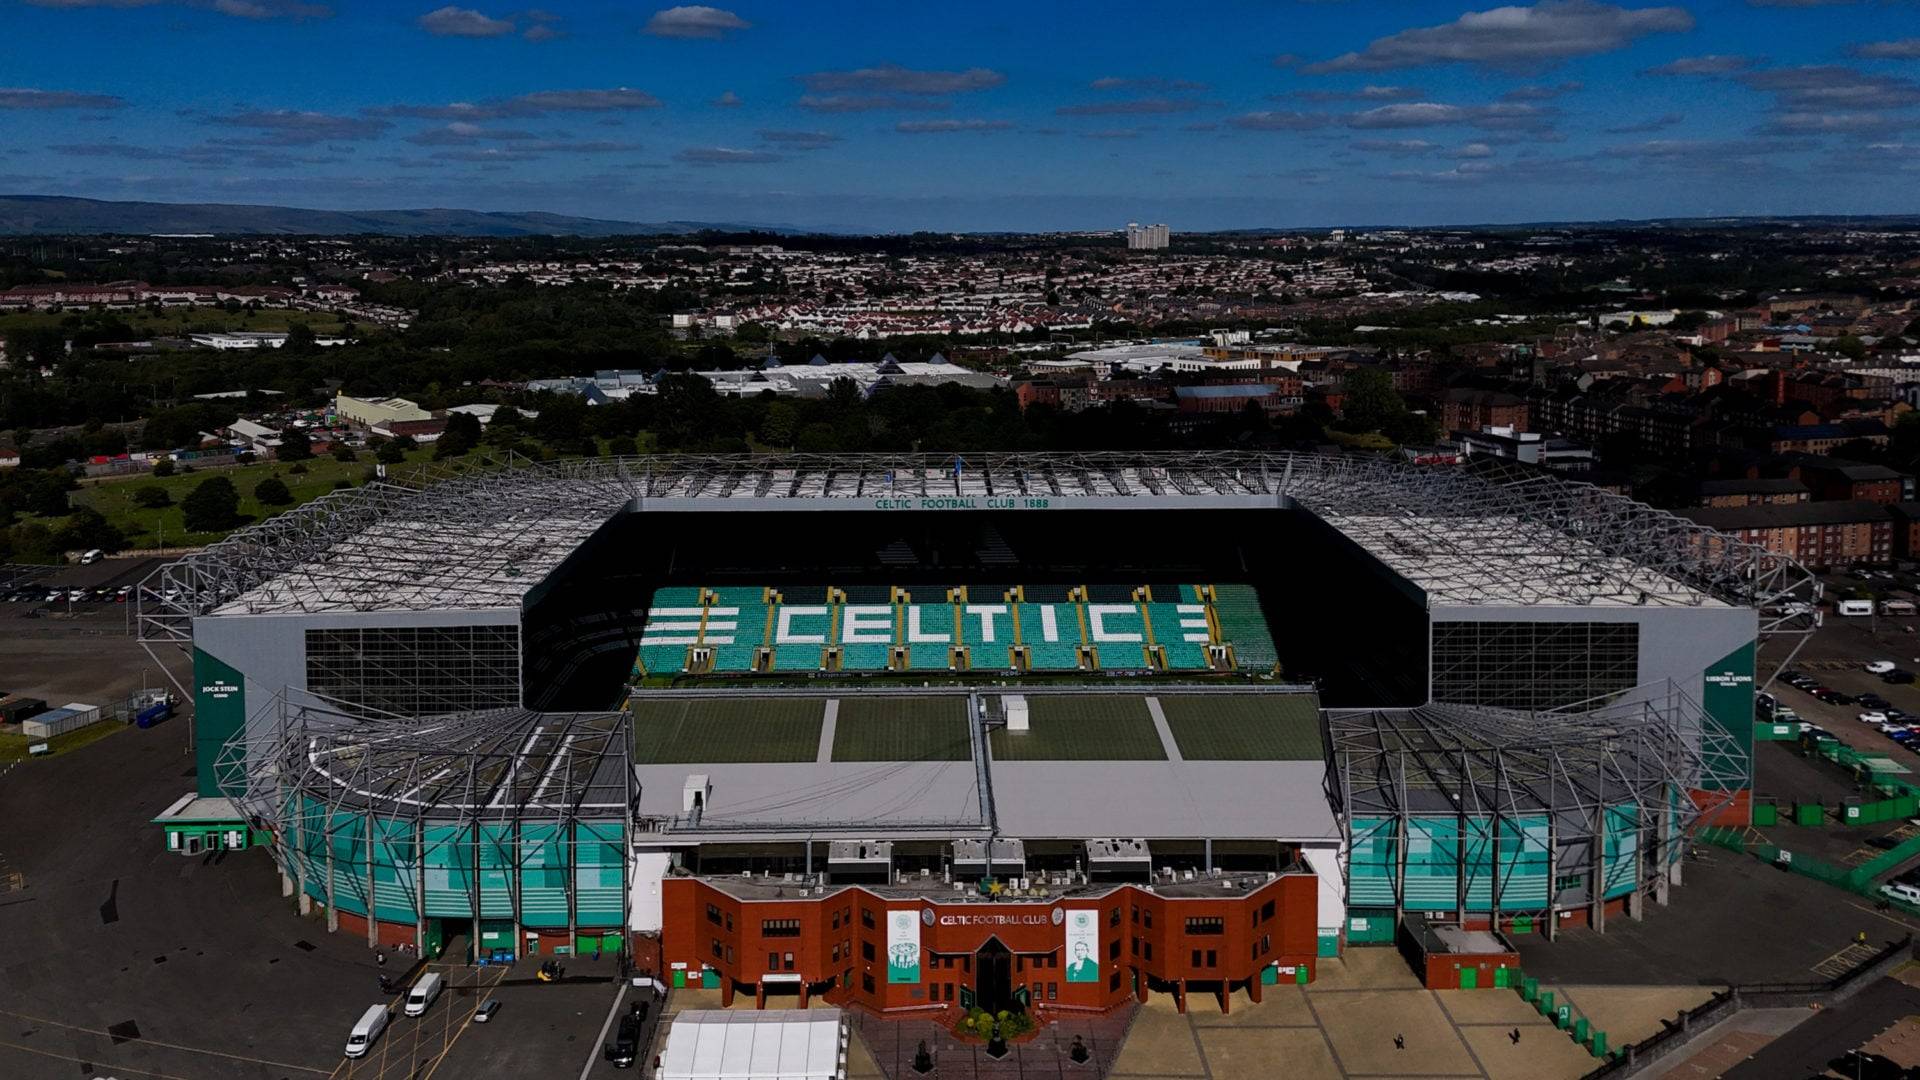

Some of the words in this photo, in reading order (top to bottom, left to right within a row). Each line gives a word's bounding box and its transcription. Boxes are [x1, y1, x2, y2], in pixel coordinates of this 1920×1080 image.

[875, 499, 911, 509] CELTIC
[921, 499, 977, 509] FOOTBALL
[987, 499, 1015, 509] CLUB
[1024, 499, 1049, 509] 1888
[776, 604, 1144, 644] CELTIC
[940, 915, 972, 925] CELTIC
[972, 915, 1021, 925] FOOTBALL
[1022, 915, 1048, 925] CLUB
[1560, 1008, 1567, 1016] A
